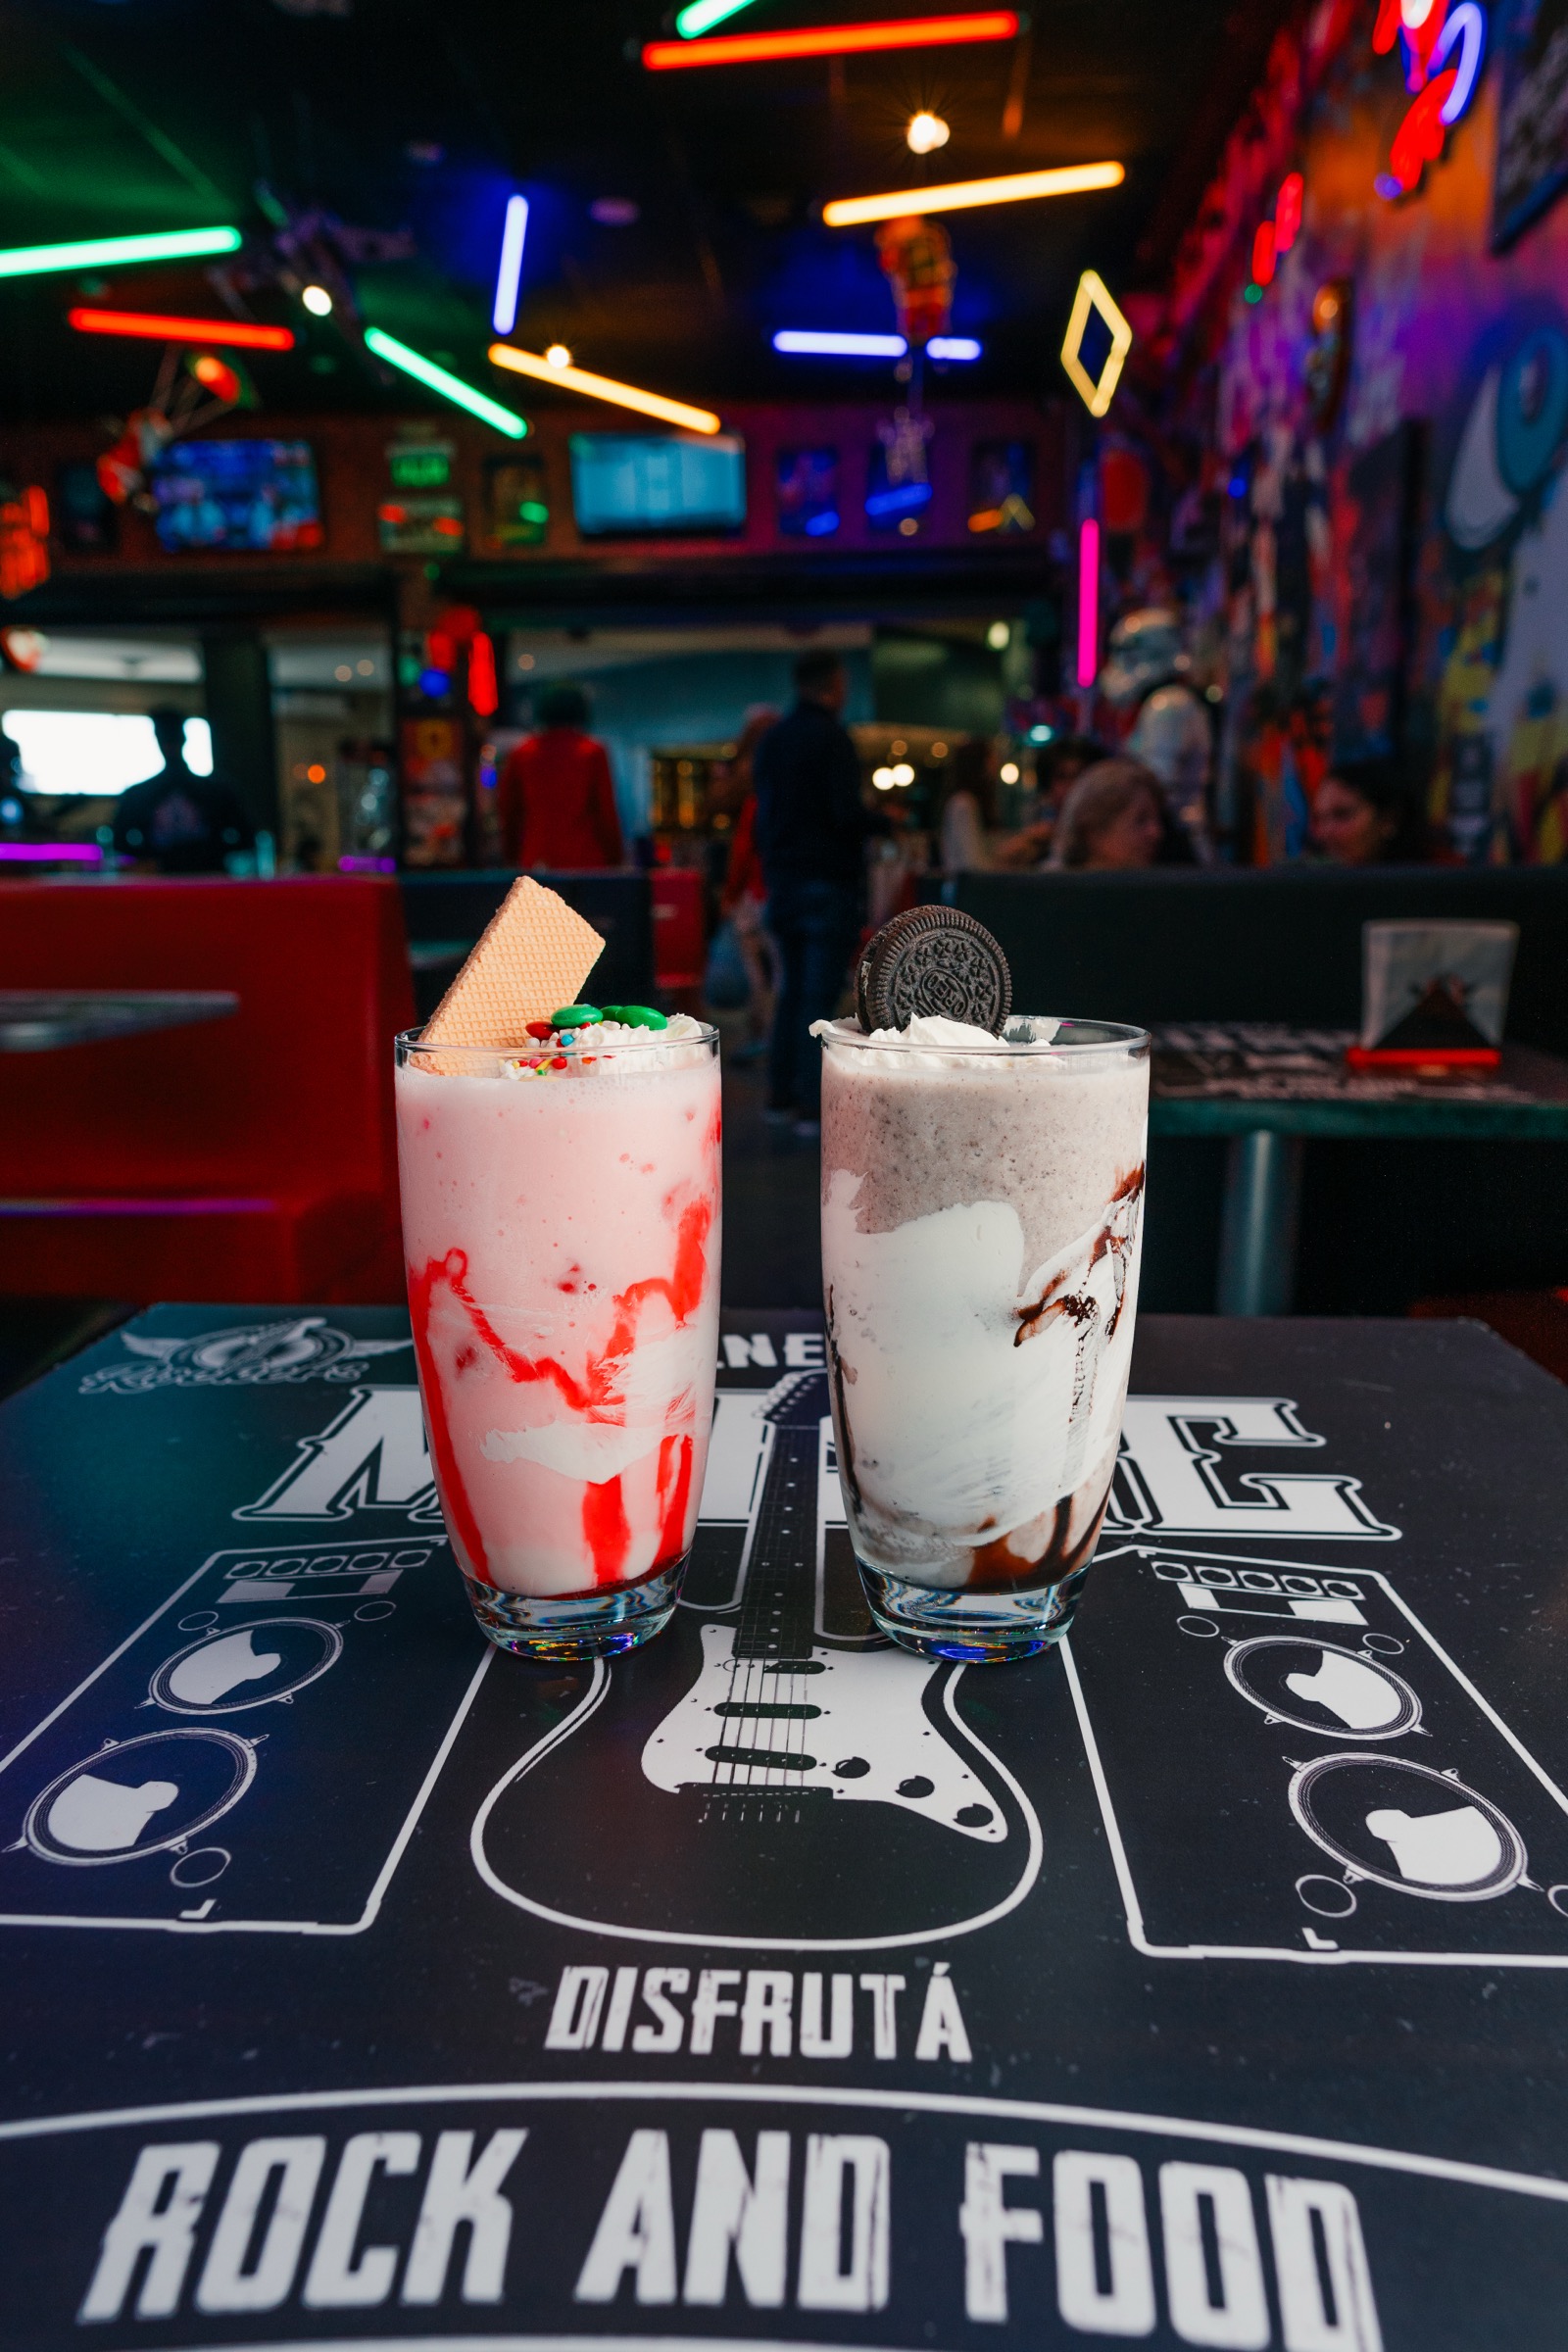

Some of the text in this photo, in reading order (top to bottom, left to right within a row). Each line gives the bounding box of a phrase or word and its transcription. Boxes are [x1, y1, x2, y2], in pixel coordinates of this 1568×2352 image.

[923, 971, 966, 1017] OREO
[544, 1962, 972, 2062] DISFRUTÁ
[76, 2128, 1384, 2352] ROCK AND FOOD
